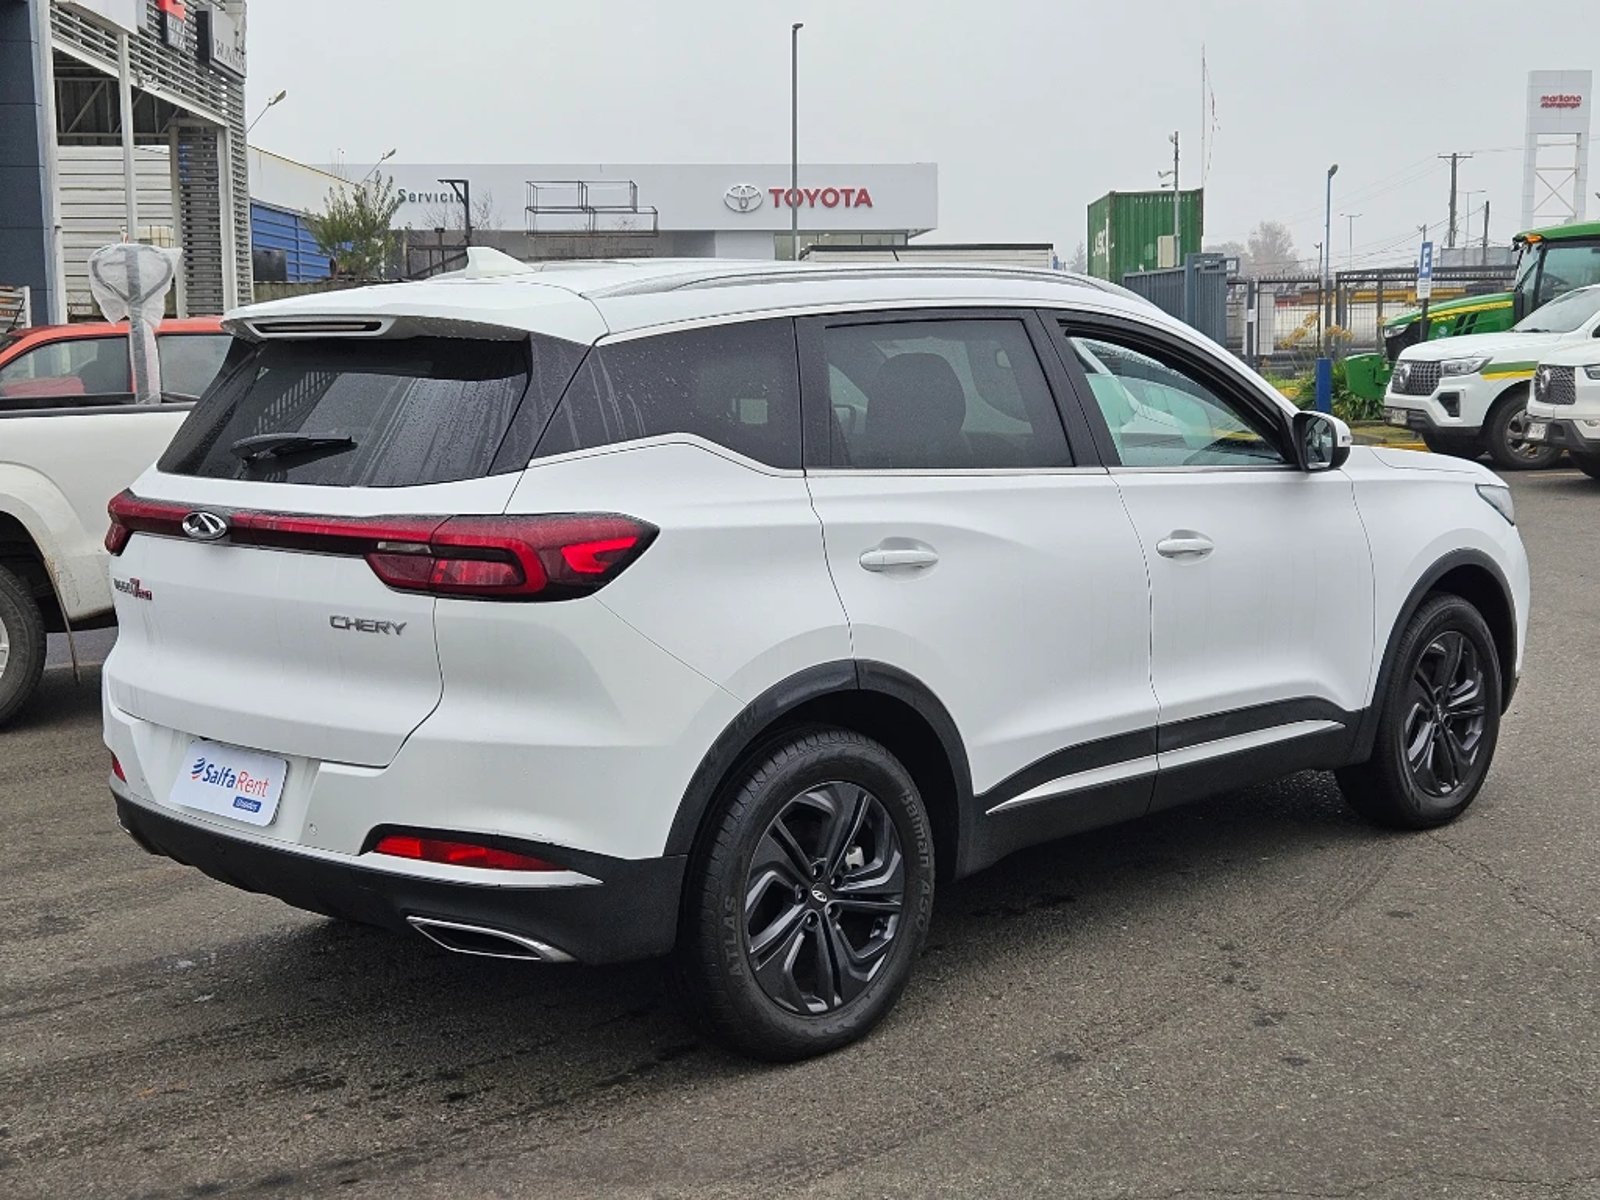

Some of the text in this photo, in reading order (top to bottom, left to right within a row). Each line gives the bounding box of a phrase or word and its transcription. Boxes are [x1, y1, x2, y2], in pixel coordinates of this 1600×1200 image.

[768, 187, 873, 208] TOYOTA
[1421, 247, 1430, 273] E
[329, 615, 408, 636] CHERY
[723, 895, 744, 976] ATLAS
